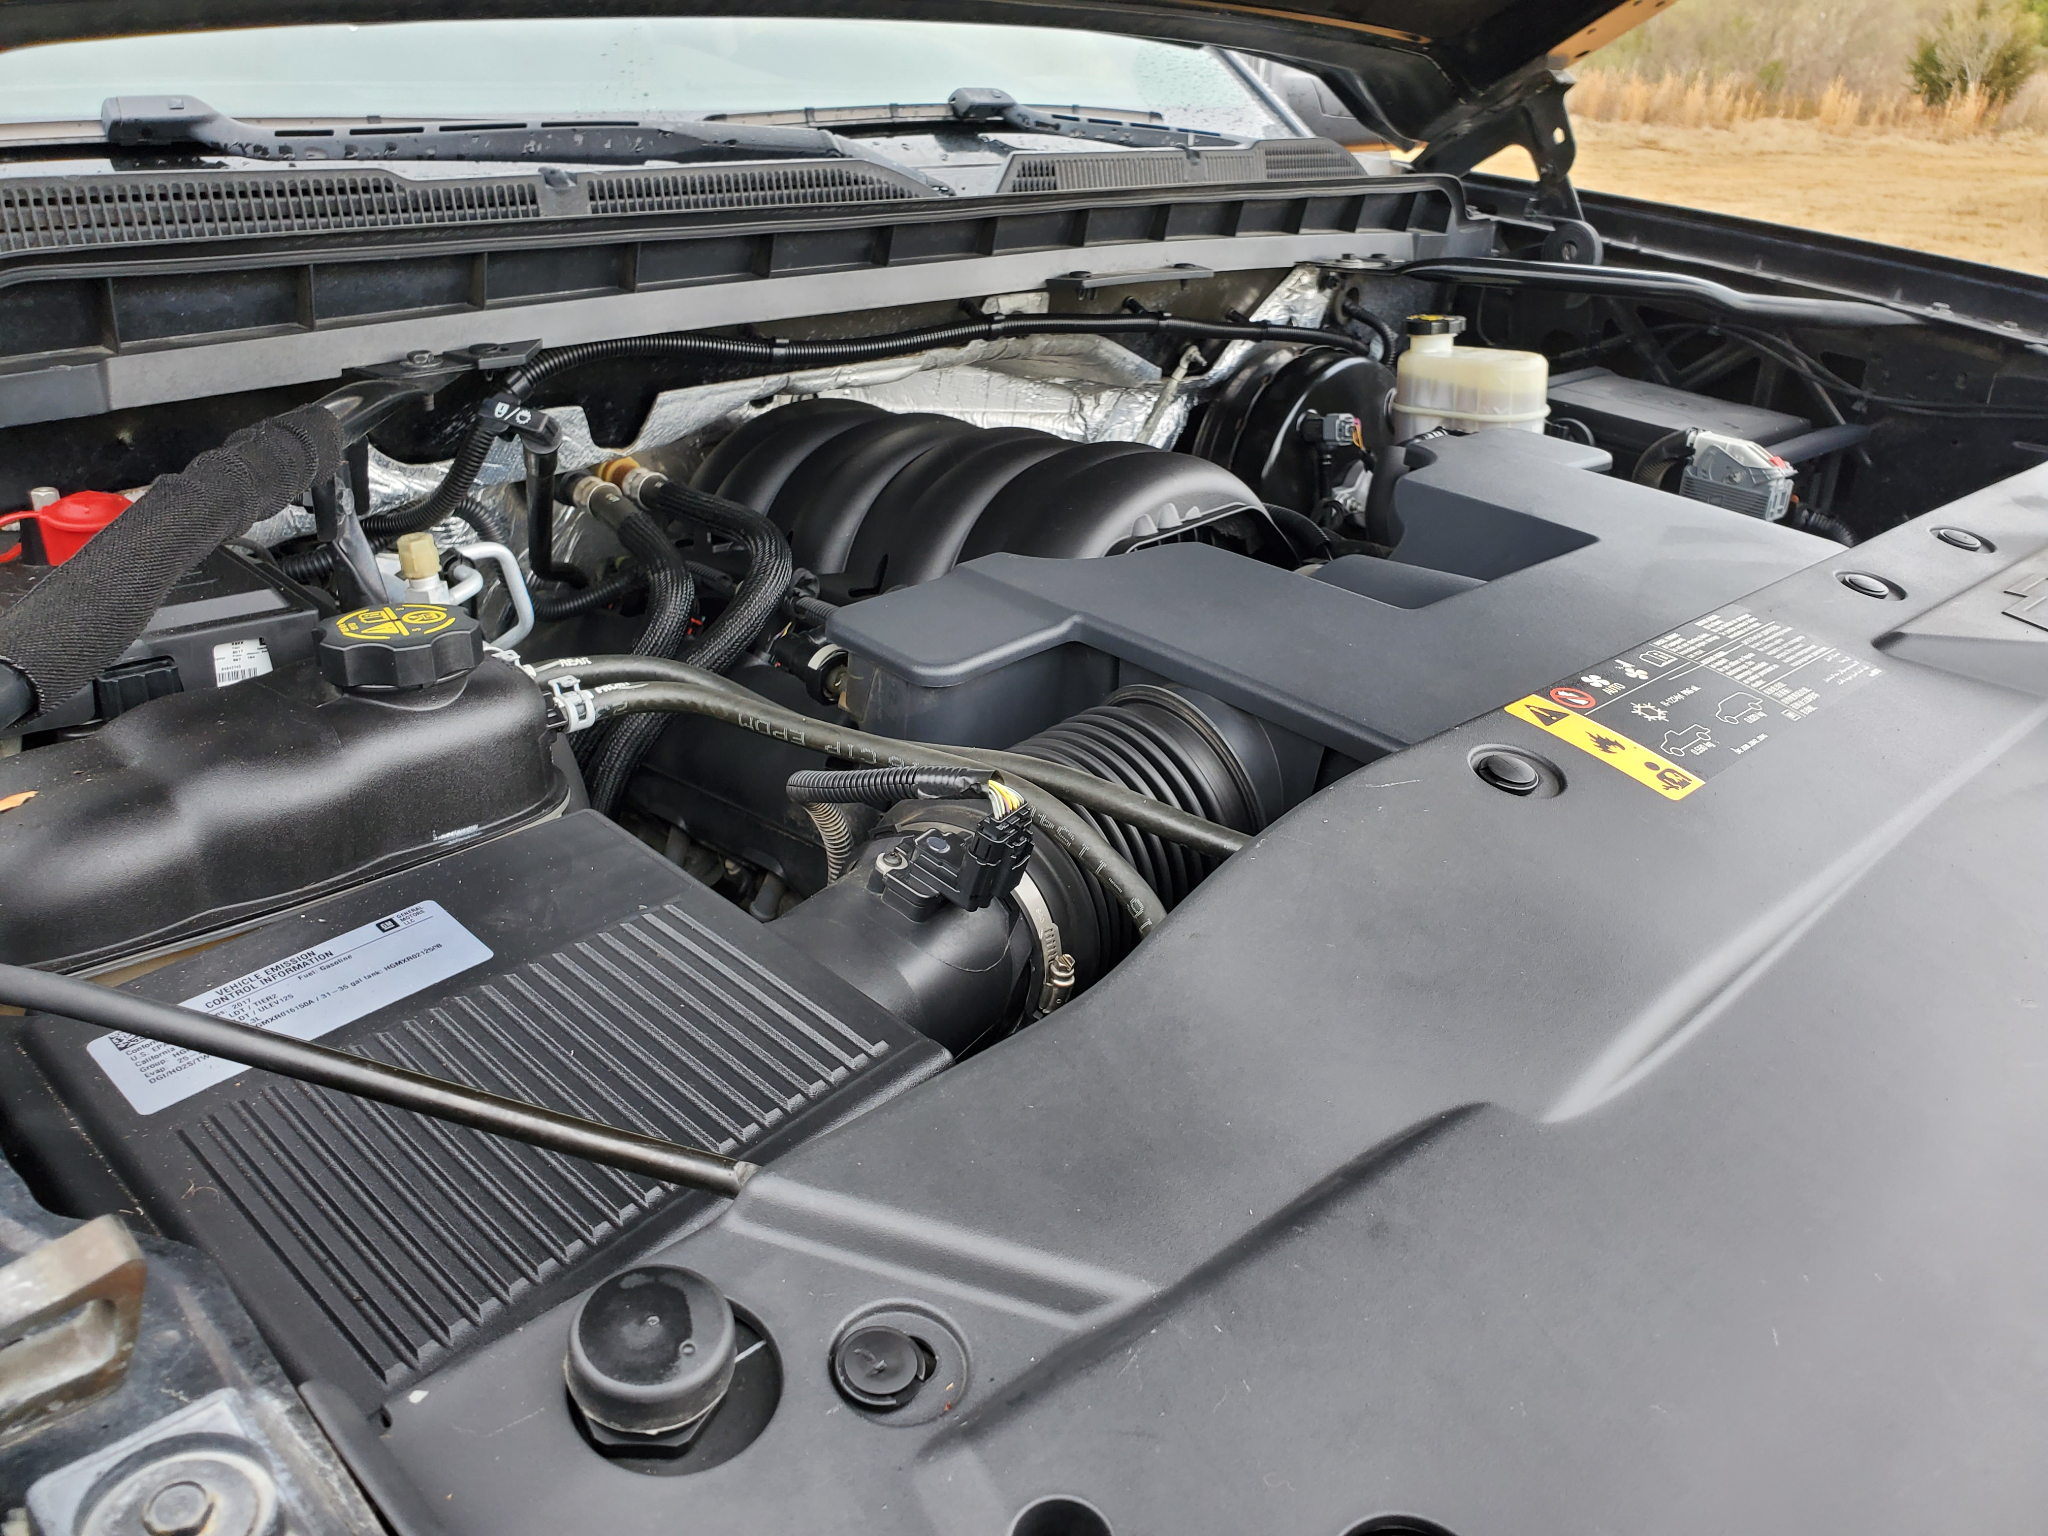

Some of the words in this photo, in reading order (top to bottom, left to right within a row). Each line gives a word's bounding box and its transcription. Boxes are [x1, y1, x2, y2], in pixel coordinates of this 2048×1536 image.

[559, 657, 592, 667] REAR
[396, 906, 424, 918] GENERAL
[400, 910, 425, 922] MOTORS
[215, 972, 263, 996] VEHICLE
[264, 950, 317, 976] EMISSION
[297, 970, 319, 981] Fuel:
[319, 954, 353, 972] Gasoline
[205, 984, 259, 1009] CONTROL
[261, 950, 334, 985] INFORMATION
[228, 1007, 246, 1018] LDT
[253, 993, 279, 1007] TIER2
[231, 997, 251, 1010] 2017
[257, 993, 295, 1013] ULEV125
[134, 1047, 176, 1068] California
[139, 1057, 168, 1074] Group:
[144, 1065, 169, 1079] Evap:
